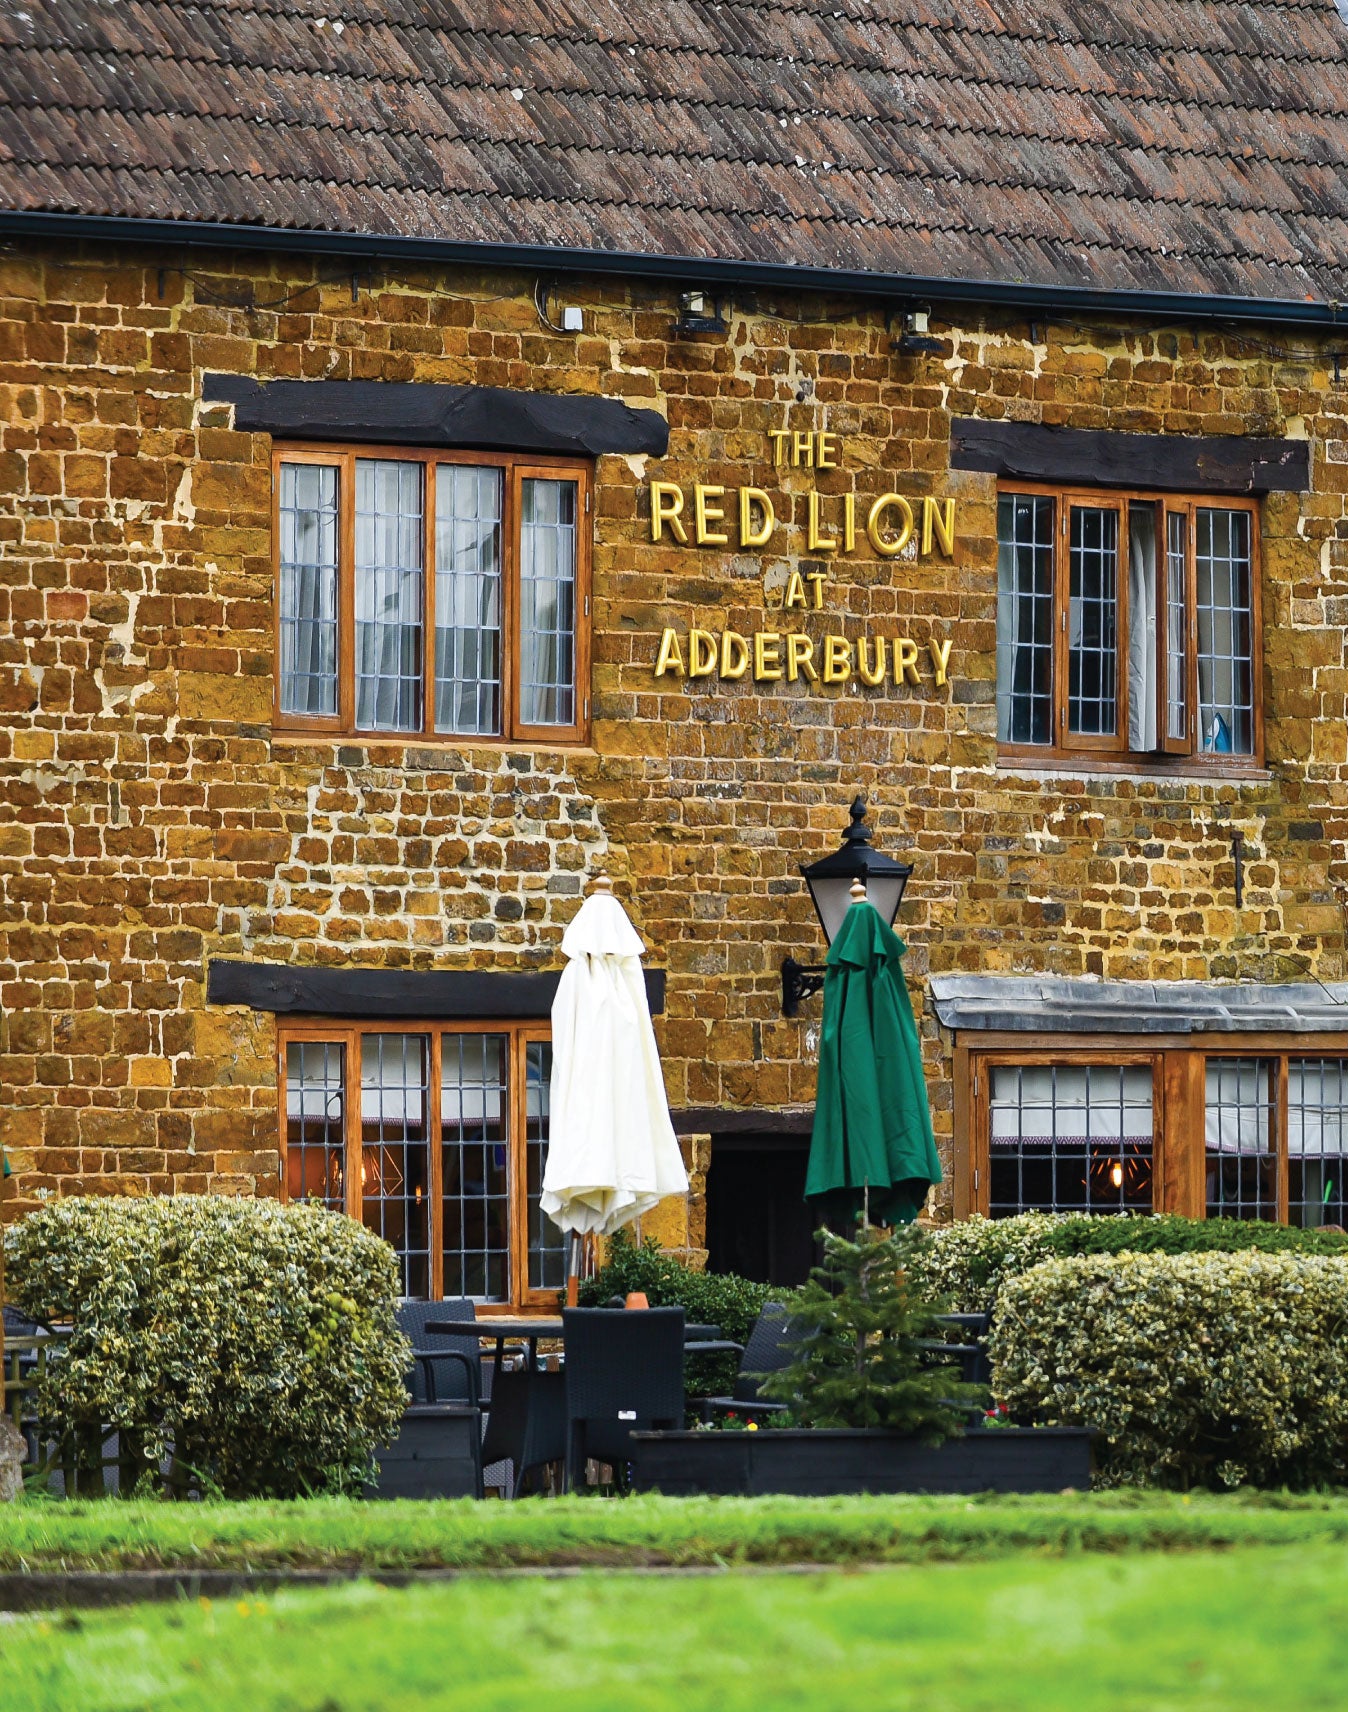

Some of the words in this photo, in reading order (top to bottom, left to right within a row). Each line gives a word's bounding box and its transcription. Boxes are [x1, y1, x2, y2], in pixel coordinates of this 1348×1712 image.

[767, 429, 837, 469] THE
[650, 481, 775, 547] RED
[808, 490, 956, 557] LION
[784, 571, 828, 610] AT
[654, 627, 954, 688] ADDERBURY
